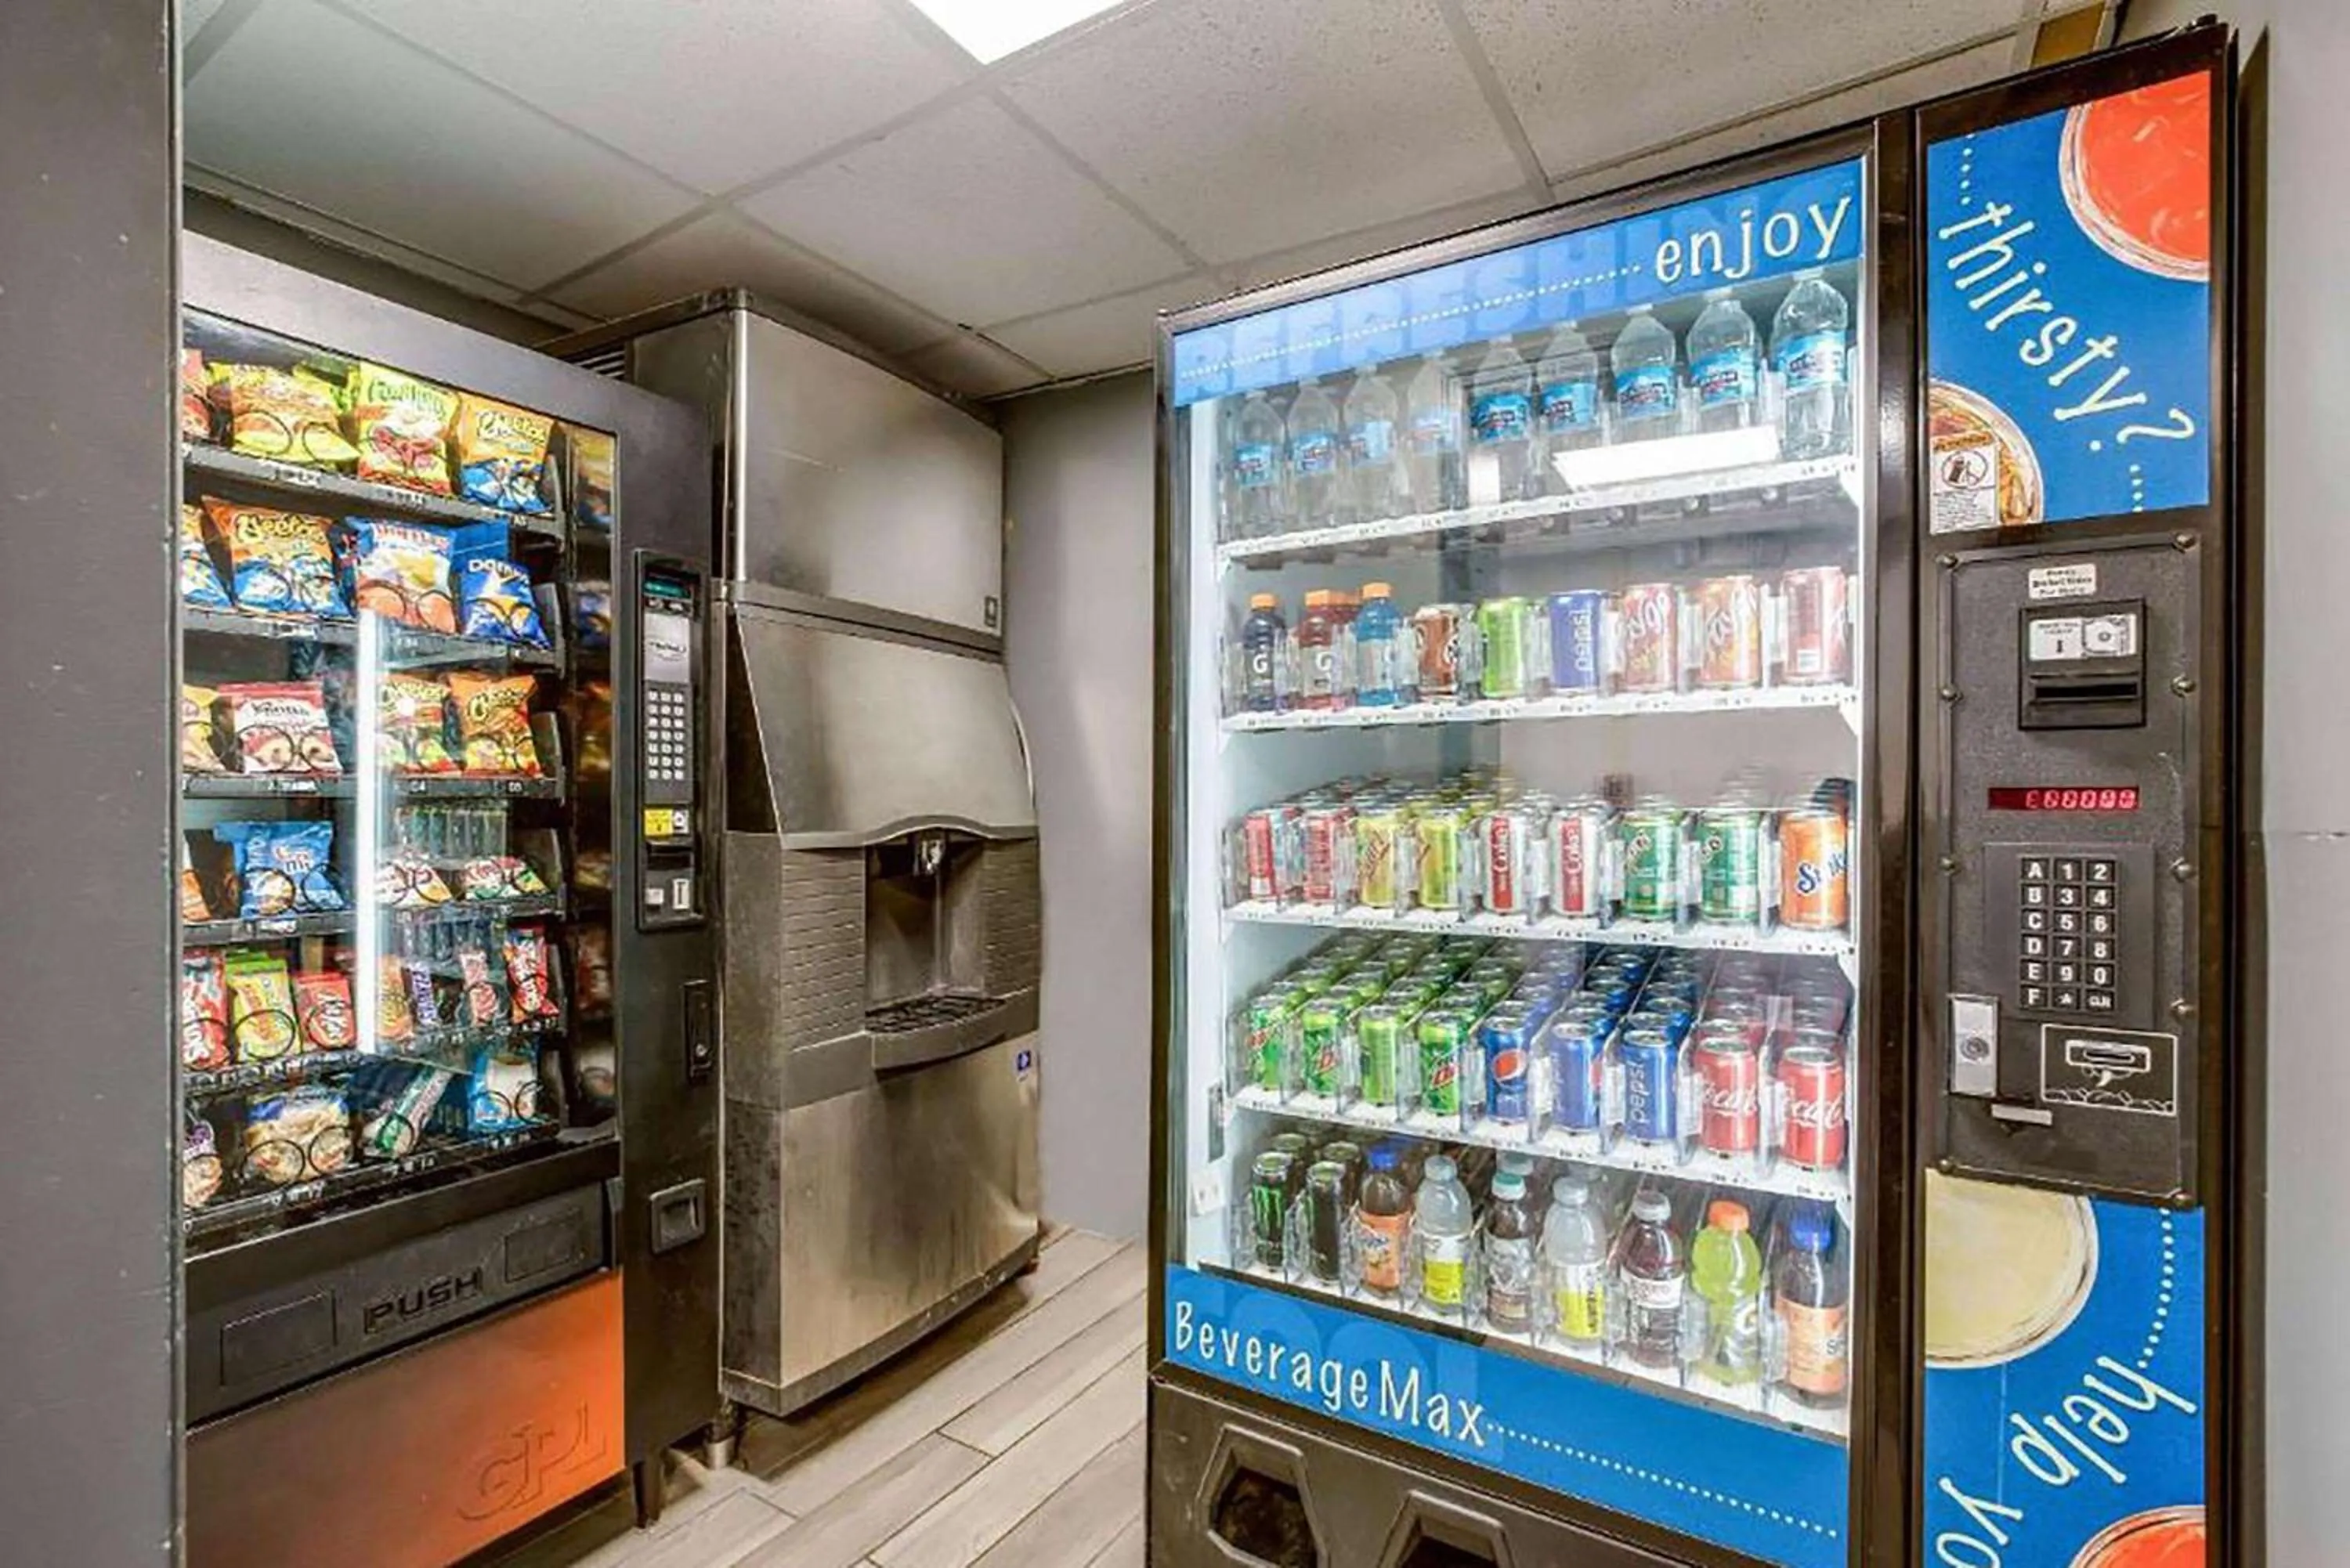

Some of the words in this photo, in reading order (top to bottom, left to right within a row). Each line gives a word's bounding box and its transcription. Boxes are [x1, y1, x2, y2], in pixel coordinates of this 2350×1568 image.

[1654, 195, 1851, 283] enjoy
[1938, 201, 2195, 453] thirsty?
[1253, 652, 1268, 674] G
[2028, 864, 2041, 878] A
[2061, 865, 2073, 879] 1
[2095, 865, 2107, 880] 2
[2028, 887, 2041, 903] B
[2061, 889, 2073, 904] 3
[2095, 891, 2107, 905] 4
[2028, 913, 2041, 928] C
[2061, 916, 2073, 930] 5
[2095, 916, 2107, 930] 6
[2028, 938, 2041, 953] D
[2061, 940, 2073, 956] 7
[2095, 943, 2107, 958] 8
[2028, 965, 2041, 979] E
[2061, 966, 2073, 981] 9
[2095, 969, 2107, 984] 0
[2028, 989, 2041, 1004] F
[363, 1266, 483, 1335] PUSH
[1173, 1299, 1488, 1449] BeverageMax
[2010, 1356, 2197, 1487] help
